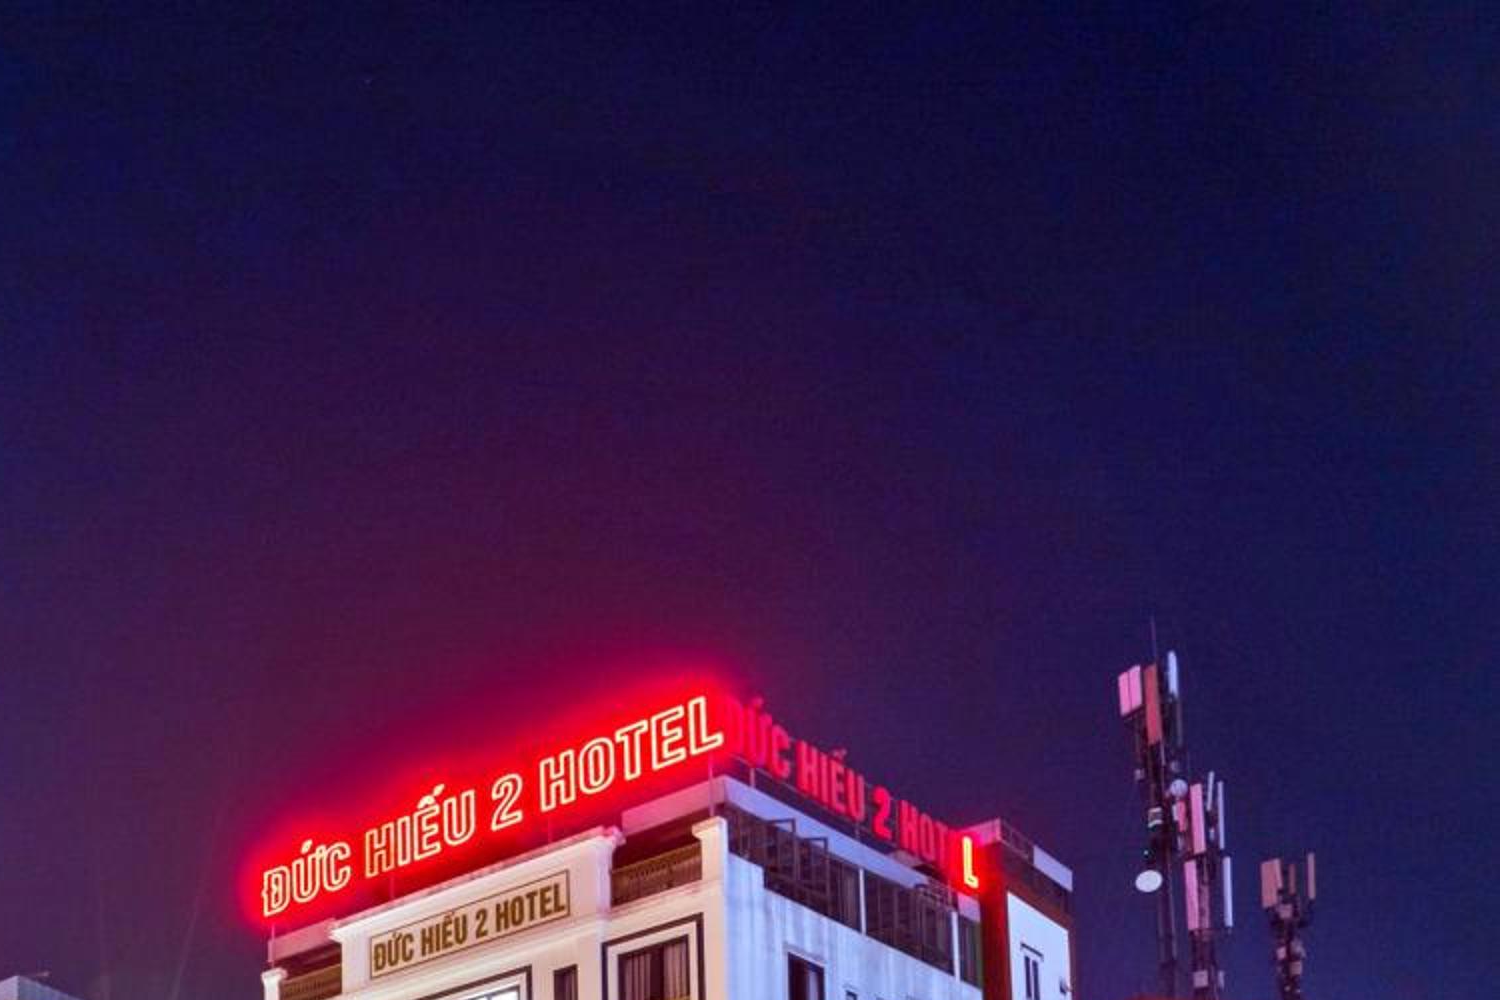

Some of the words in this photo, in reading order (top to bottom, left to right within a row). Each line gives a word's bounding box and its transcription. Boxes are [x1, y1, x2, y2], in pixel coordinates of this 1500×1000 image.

[261, 838, 352, 917] ĐỨC
[364, 784, 477, 878] HIẾU
[491, 773, 524, 832] 2
[539, 696, 725, 813] HOTEL
[795, 739, 866, 823] HIẾU
[871, 784, 893, 841] 2
[373, 931, 414, 971] ĐỨC
[421, 910, 468, 957] HIẾU
[475, 909, 488, 939] 2
[495, 883, 566, 933] HOTEL
